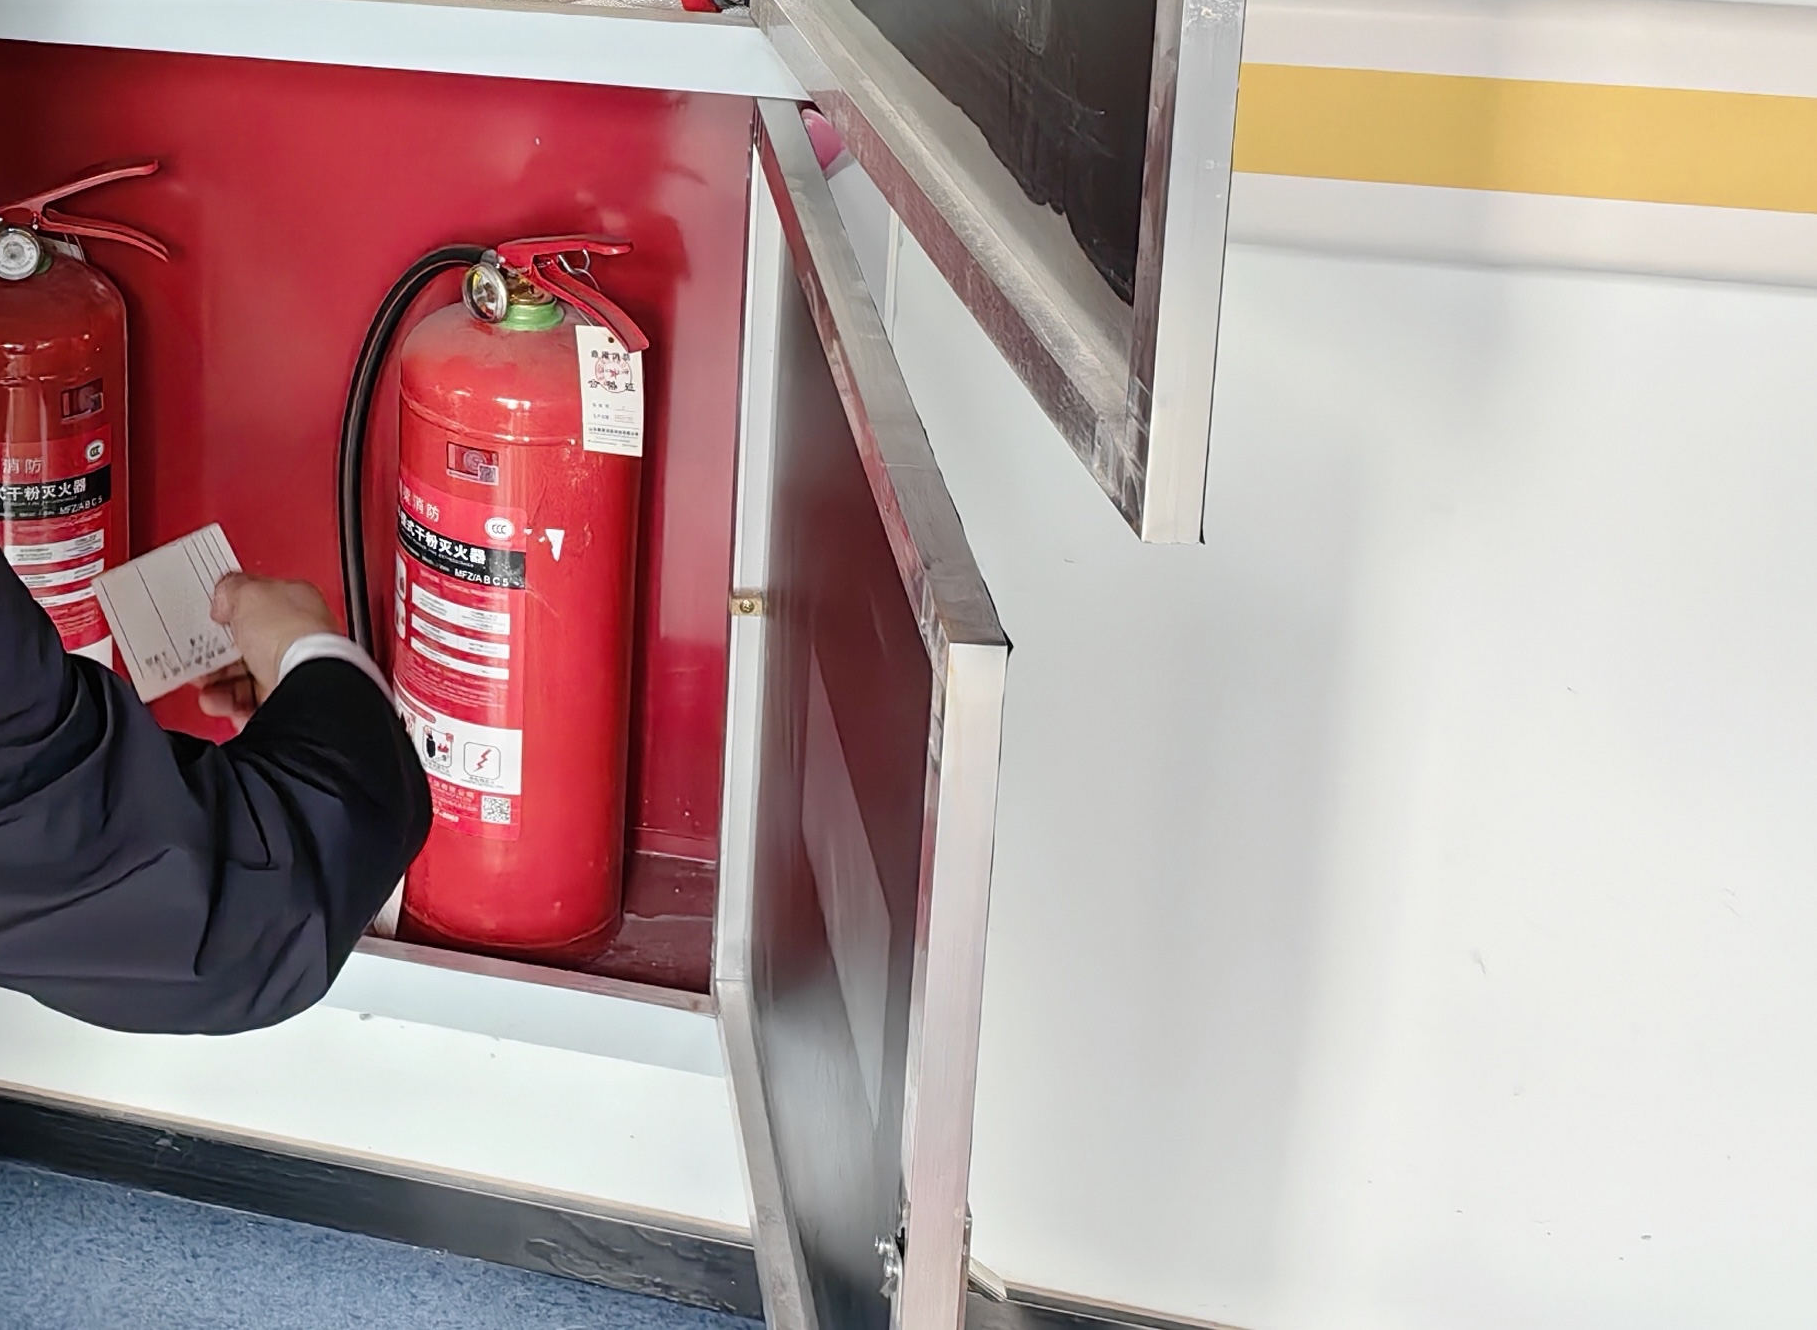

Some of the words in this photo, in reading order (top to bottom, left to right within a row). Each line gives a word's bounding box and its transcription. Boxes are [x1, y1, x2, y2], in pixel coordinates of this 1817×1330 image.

[398, 505, 486, 564] 提式干粉灭火器
